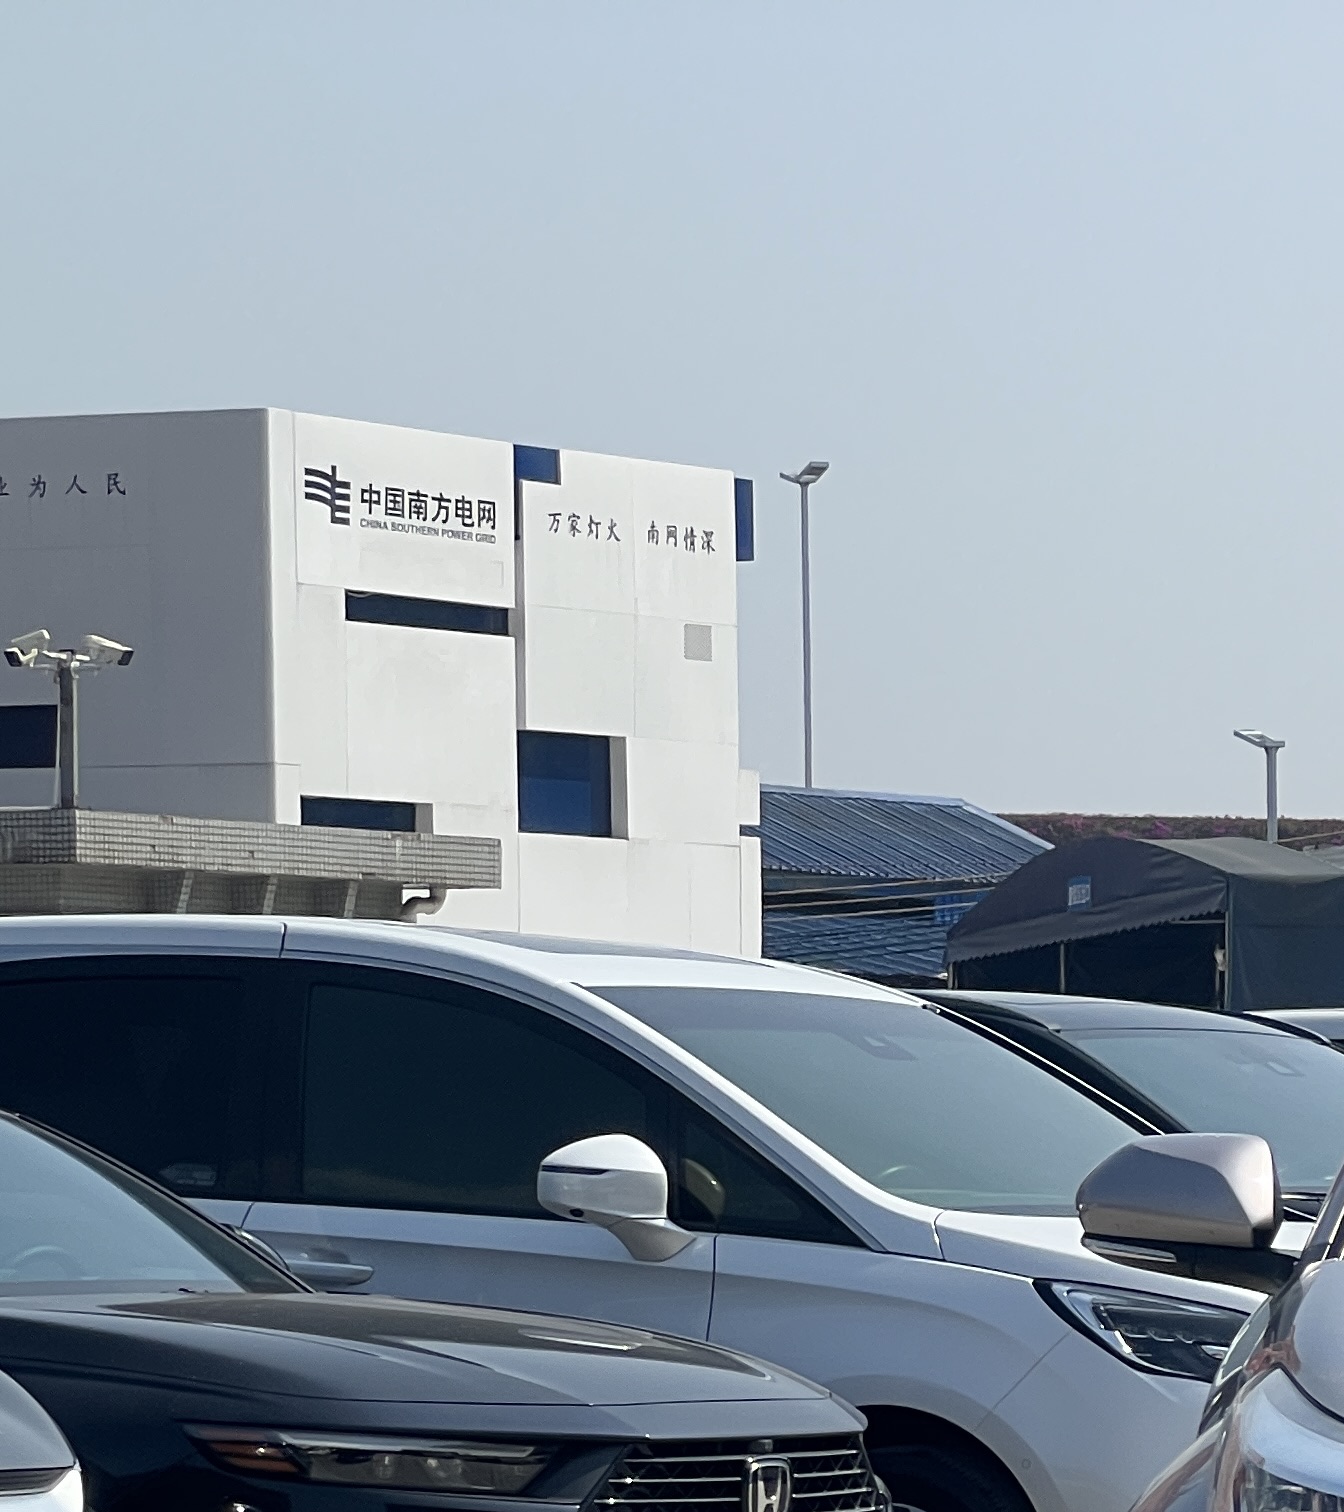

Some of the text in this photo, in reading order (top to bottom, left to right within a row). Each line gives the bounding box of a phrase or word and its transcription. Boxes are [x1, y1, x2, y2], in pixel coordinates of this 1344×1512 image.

[360, 483, 496, 531] 中国南方电网
[359, 517, 389, 531] CHINA
[390, 521, 440, 538] SOUTHERN
[441, 528, 474, 542] POWER
[547, 511, 622, 543] 万家灯火
